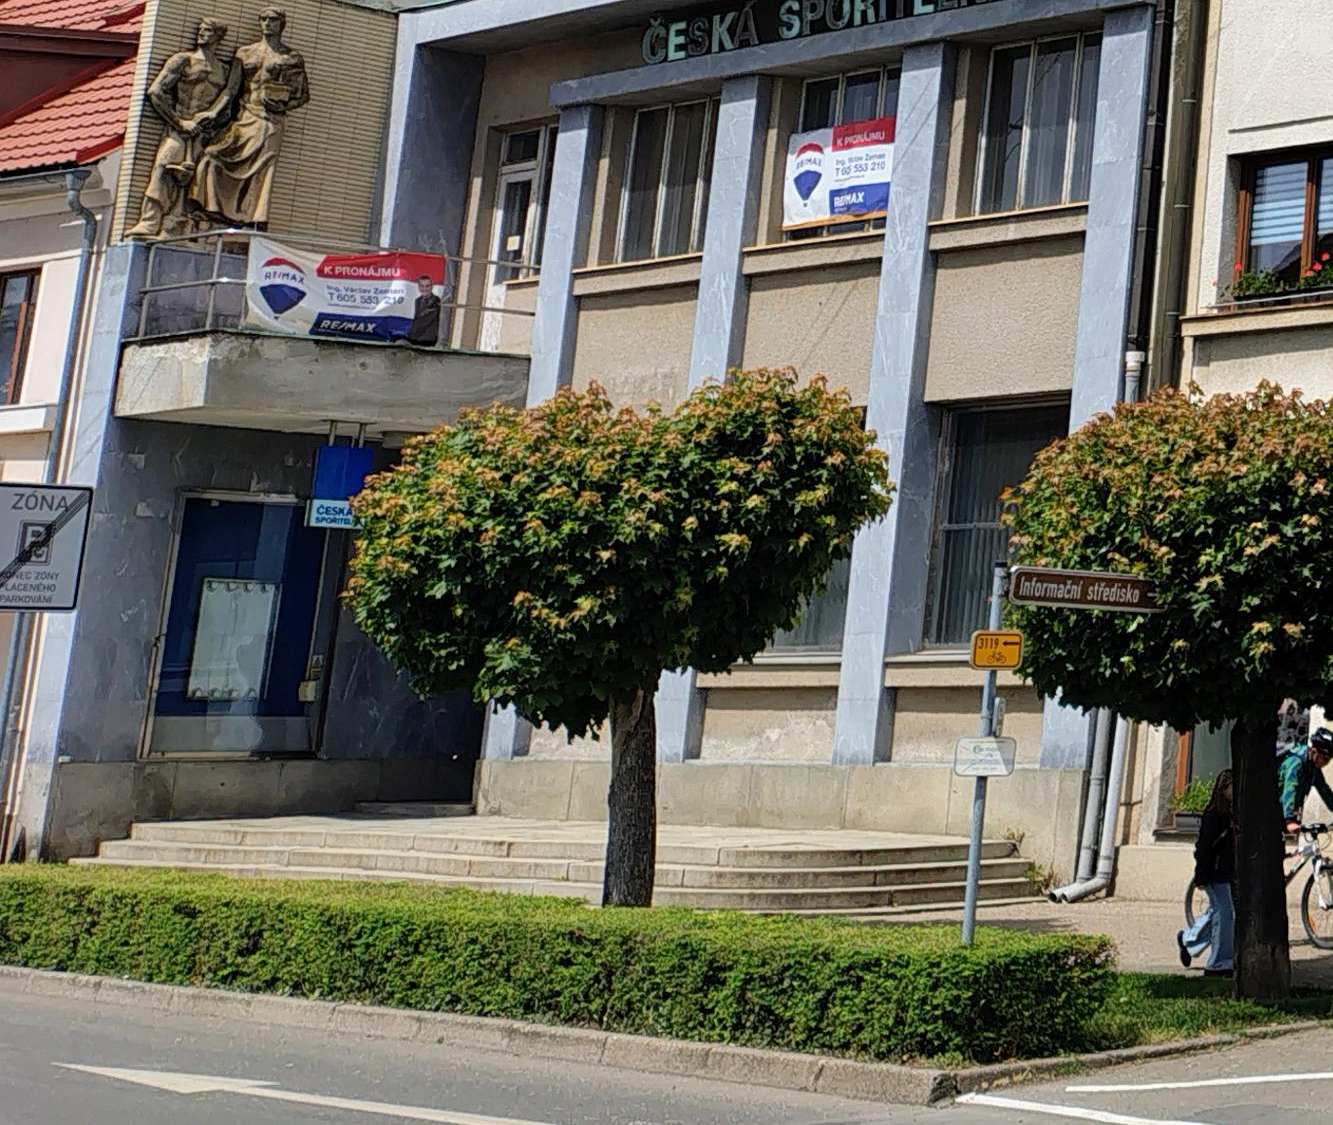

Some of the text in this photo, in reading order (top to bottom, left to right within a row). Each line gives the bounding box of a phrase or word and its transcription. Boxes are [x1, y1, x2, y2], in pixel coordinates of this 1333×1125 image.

[642, 0, 760, 65] ČESKÁ
[836, 138, 843, 148] K
[853, 163, 868, 173] 553
[870, 161, 886, 171] 210
[265, 271, 305, 284] RE/MAX
[323, 265, 401, 277] K PRONÁJMU
[328, 292, 335, 301] T
[337, 293, 357, 304] 605
[360, 295, 379, 305] 553
[320, 320, 376, 333] RE/MAX
[11, 490, 69, 511] ZÓNA
[34, 570, 60, 581] ZÓNY
[1019, 576, 1140, 603] Informační středisko
[978, 637, 1000, 650] 3119
